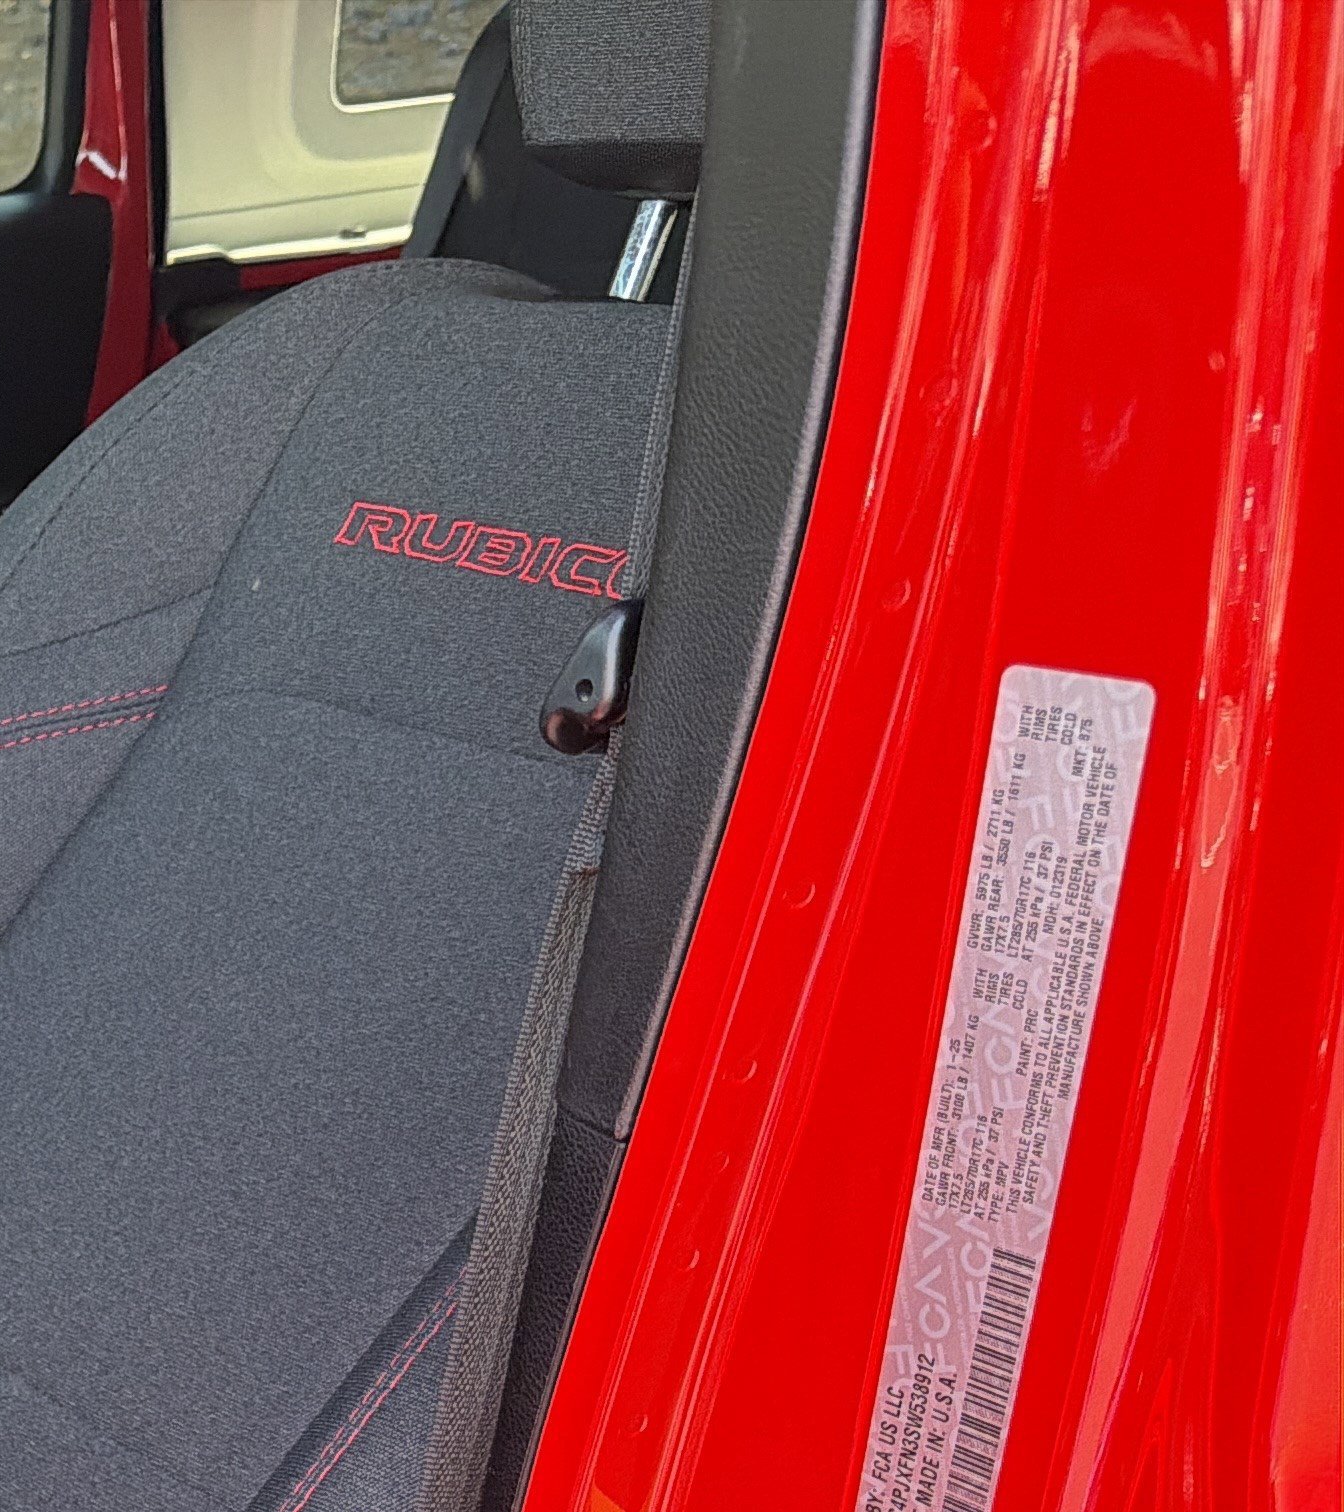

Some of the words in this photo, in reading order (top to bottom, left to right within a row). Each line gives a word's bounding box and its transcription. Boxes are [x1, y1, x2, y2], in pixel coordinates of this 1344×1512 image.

[1017, 704, 1034, 738] WITH
[1030, 708, 1047, 741] RIMS
[1044, 705, 1063, 743] TIRES
[1059, 711, 1077, 746] COLD
[1012, 752, 1026, 770] KG
[1083, 745, 1106, 798] VEHICLE
[1103, 761, 1119, 780] OF
[991, 787, 1004, 805] KG
[1007, 774, 1022, 801] 1611
[1096, 782, 1115, 816] DATE
[986, 810, 1000, 837] 2711
[1001, 819, 1014, 834] LB
[1075, 801, 1095, 846] MOTOR
[1090, 820, 1107, 845] THE
[980, 854, 993, 869] LB
[1022, 850, 1036, 871] 116
[1039, 839, 1054, 861] PSI
[1086, 848, 1102, 867] ON
[1036, 863, 1049, 879] 37
[1049, 855, 1068, 898] 012319
[1064, 849, 1086, 906] FEDERAL
[974, 871, 990, 901] 5975
[1077, 871, 1098, 917] EFFECT
[1028, 895, 1043, 918] kPa
[966, 907, 984, 949] GVWR:
[980, 914, 997, 952] GAWR
[1024, 920, 1039, 942] 255
[1074, 919, 1088, 934] IN
[1020, 945, 1034, 962] AT
[972, 967, 987, 999] WITH
[984, 972, 999, 1003] RIMS
[1041, 951, 1067, 1024] APPLICABLE
[1059, 936, 1085, 1011] STANDARDS
[997, 971, 1014, 1006] TIRES
[1011, 978, 1028, 1010] COLD
[966, 1013, 979, 1030] KG
[1023, 1007, 1039, 1033] PRC
[1056, 1009, 1086, 1100] MANUFACTURE
[1075, 961, 1095, 1007] SHOWN
[961, 1032, 976, 1060] 1407
[1037, 1025, 1053, 1049] ALL
[1044, 1013, 1070, 1088] PREVENTION
[1015, 1036, 1033, 1077] PAINT:
[1033, 1051, 1048, 1068] TO
[956, 1075, 968, 1090] LB
[951, 1092, 965, 1120] 3100
[990, 1106, 1004, 1126] PSI
[1020, 1070, 1044, 1136] CONFORMS
[1036, 1091, 1054, 1129] THEFT
[930, 1125, 945, 1151] MFR
[942, 1126, 959, 1168] FRONT:
[987, 1127, 1000, 1142] 37
[1030, 1131, 1047, 1158] AND
[927, 1153, 940, 1170] OF
[980, 1156, 994, 1178] kPa
[994, 1160, 1010, 1187] MPV
[1011, 1137, 1031, 1185] VEHICLE
[921, 1170, 937, 1202] DATE
[935, 1170, 950, 1206] GAWR
[976, 1179, 990, 1201] 255
[1021, 1159, 1041, 1204] SAFETY
[973, 1202, 986, 1219] AT
[1006, 1187, 1021, 1214] THIS
[882, 1385, 904, 1418] LLC
[931, 1368, 958, 1423] U.S.A.
[877, 1420, 898, 1446] US
[925, 1426, 946, 1453] IN:
[871, 1448, 892, 1483] FCA
[914, 1455, 940, 1507] MADE
